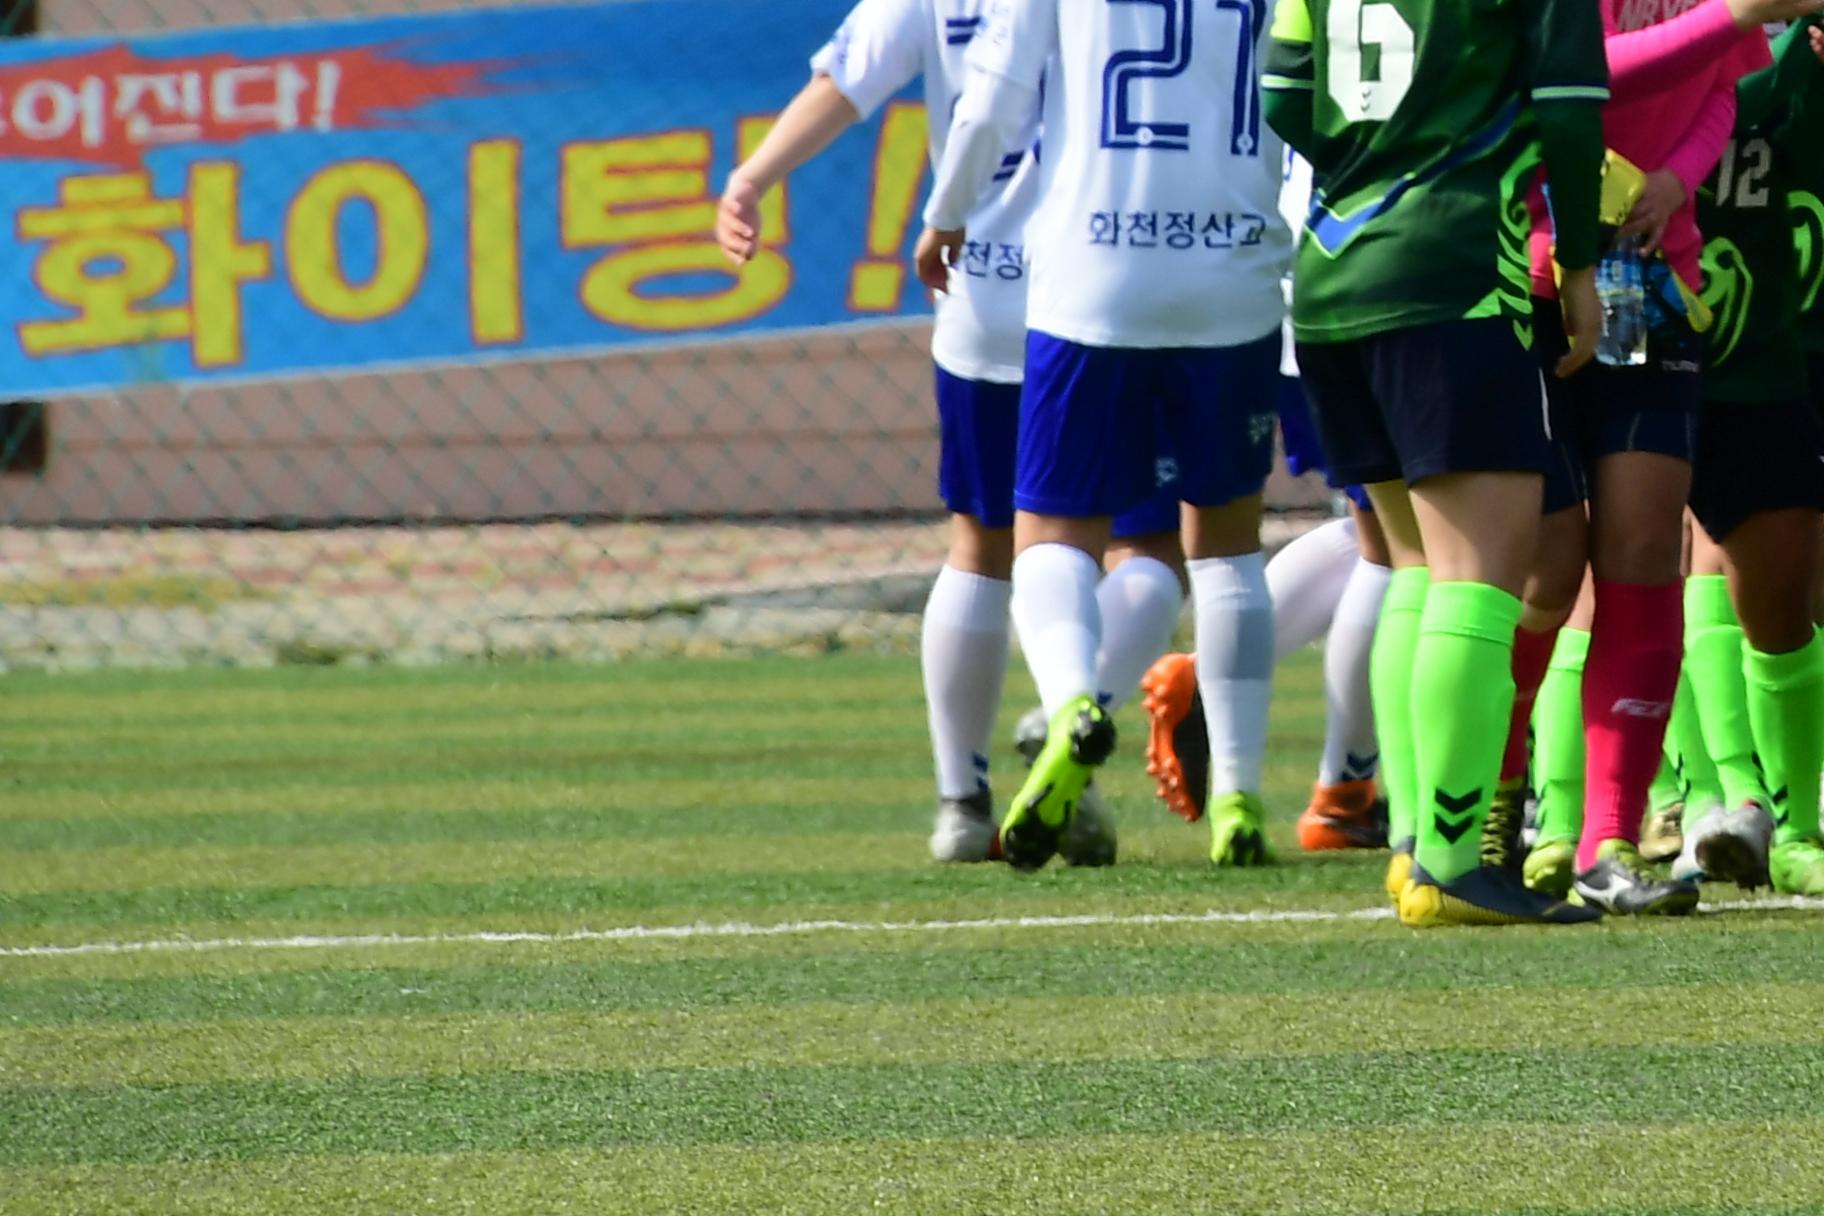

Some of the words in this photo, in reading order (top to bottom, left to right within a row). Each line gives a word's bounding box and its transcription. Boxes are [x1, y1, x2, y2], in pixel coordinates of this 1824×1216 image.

[0, 59, 341, 149] 어진다!
[1715, 137, 1772, 208] 12
[1090, 209, 1267, 251] 화천정산고
